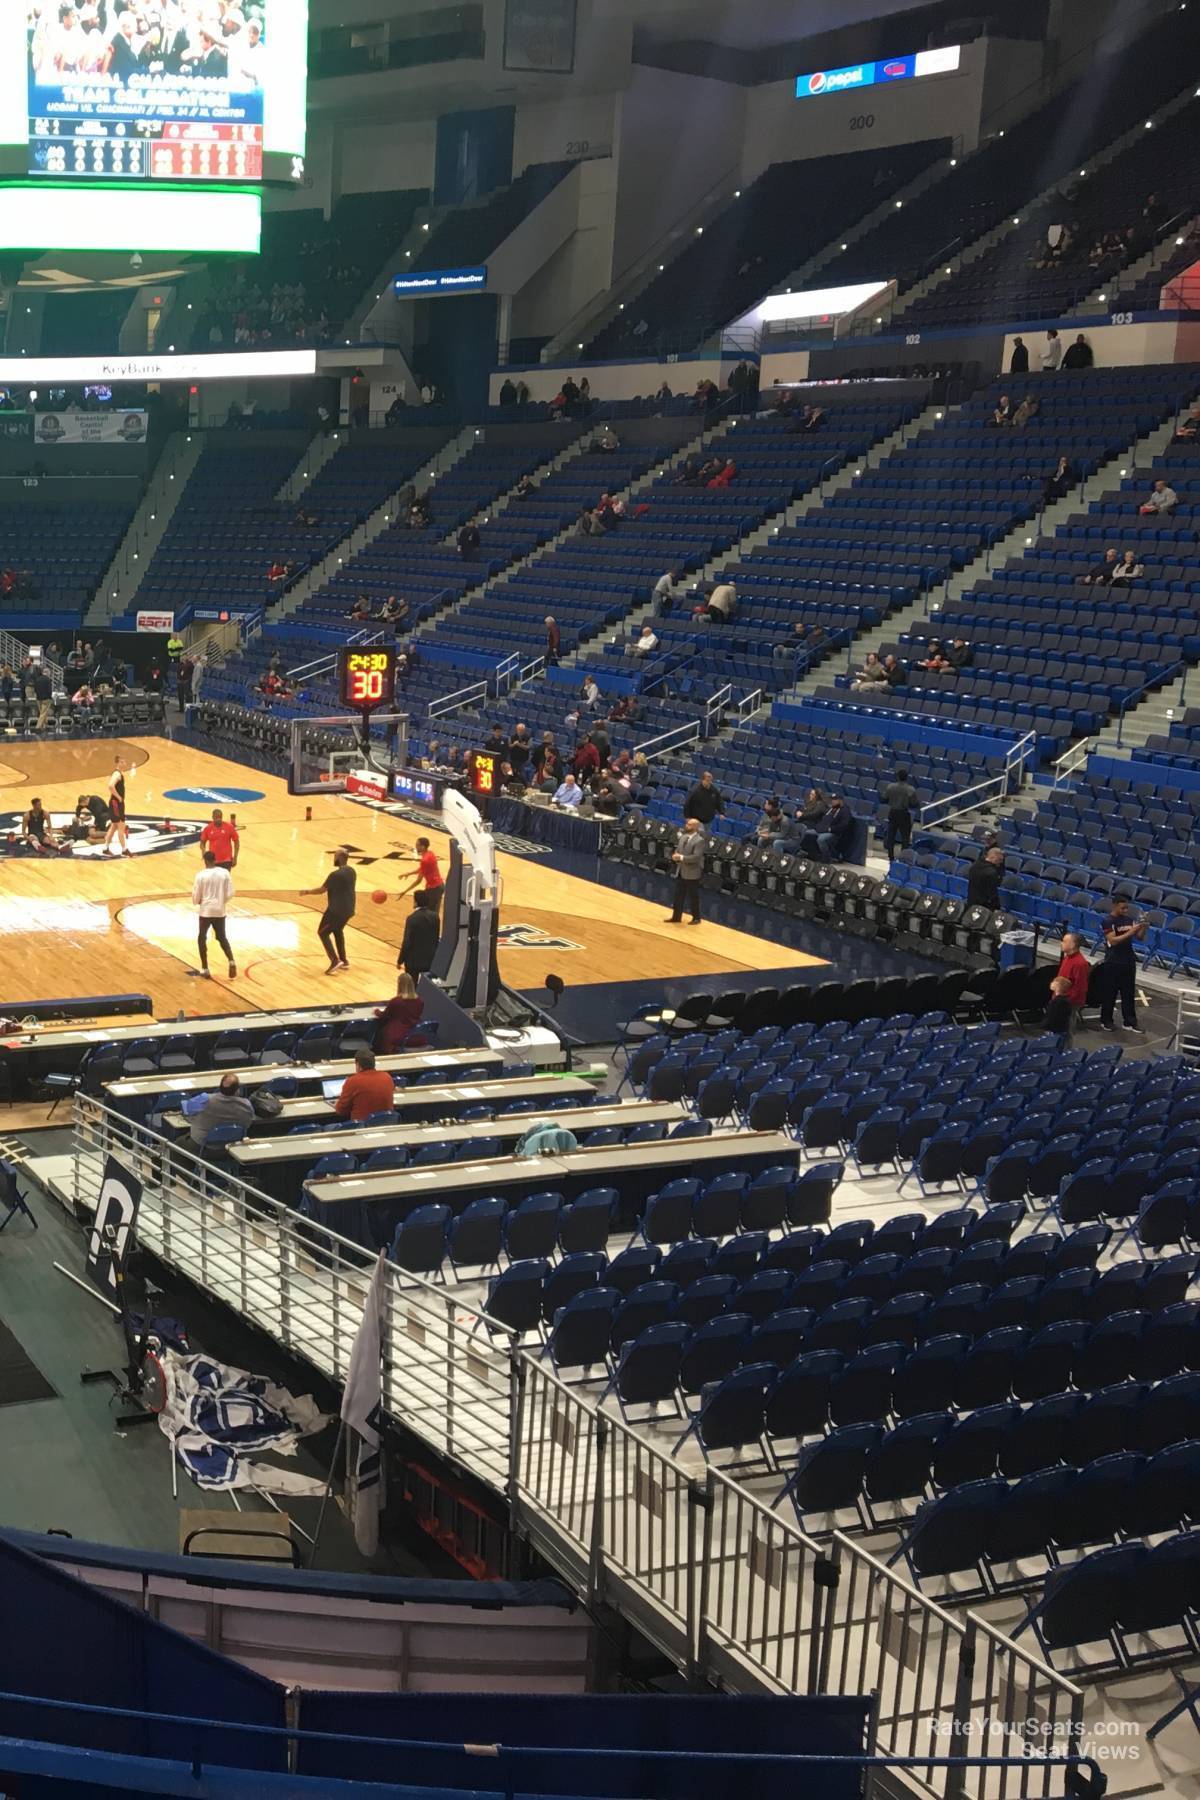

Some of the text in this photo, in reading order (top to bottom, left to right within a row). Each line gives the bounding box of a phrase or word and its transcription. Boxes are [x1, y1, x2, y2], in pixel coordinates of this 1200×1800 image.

[826, 68, 863, 90] pepsi
[849, 114, 875, 130] 200
[566, 141, 589, 154] 230
[1110, 312, 1134, 326] 103
[905, 334, 921, 345] 102
[666, 354, 679, 363] 101
[102, 363, 162, 376] KeyBank
[382, 384, 397, 394] 124
[23, 479, 39, 487] 123
[138, 616, 172, 627] ESPN
[349, 654, 387, 671] 24:30
[354, 671, 382, 699] 30
[395, 775, 432, 794] CBS CBS
[479, 771, 493, 789] 30
